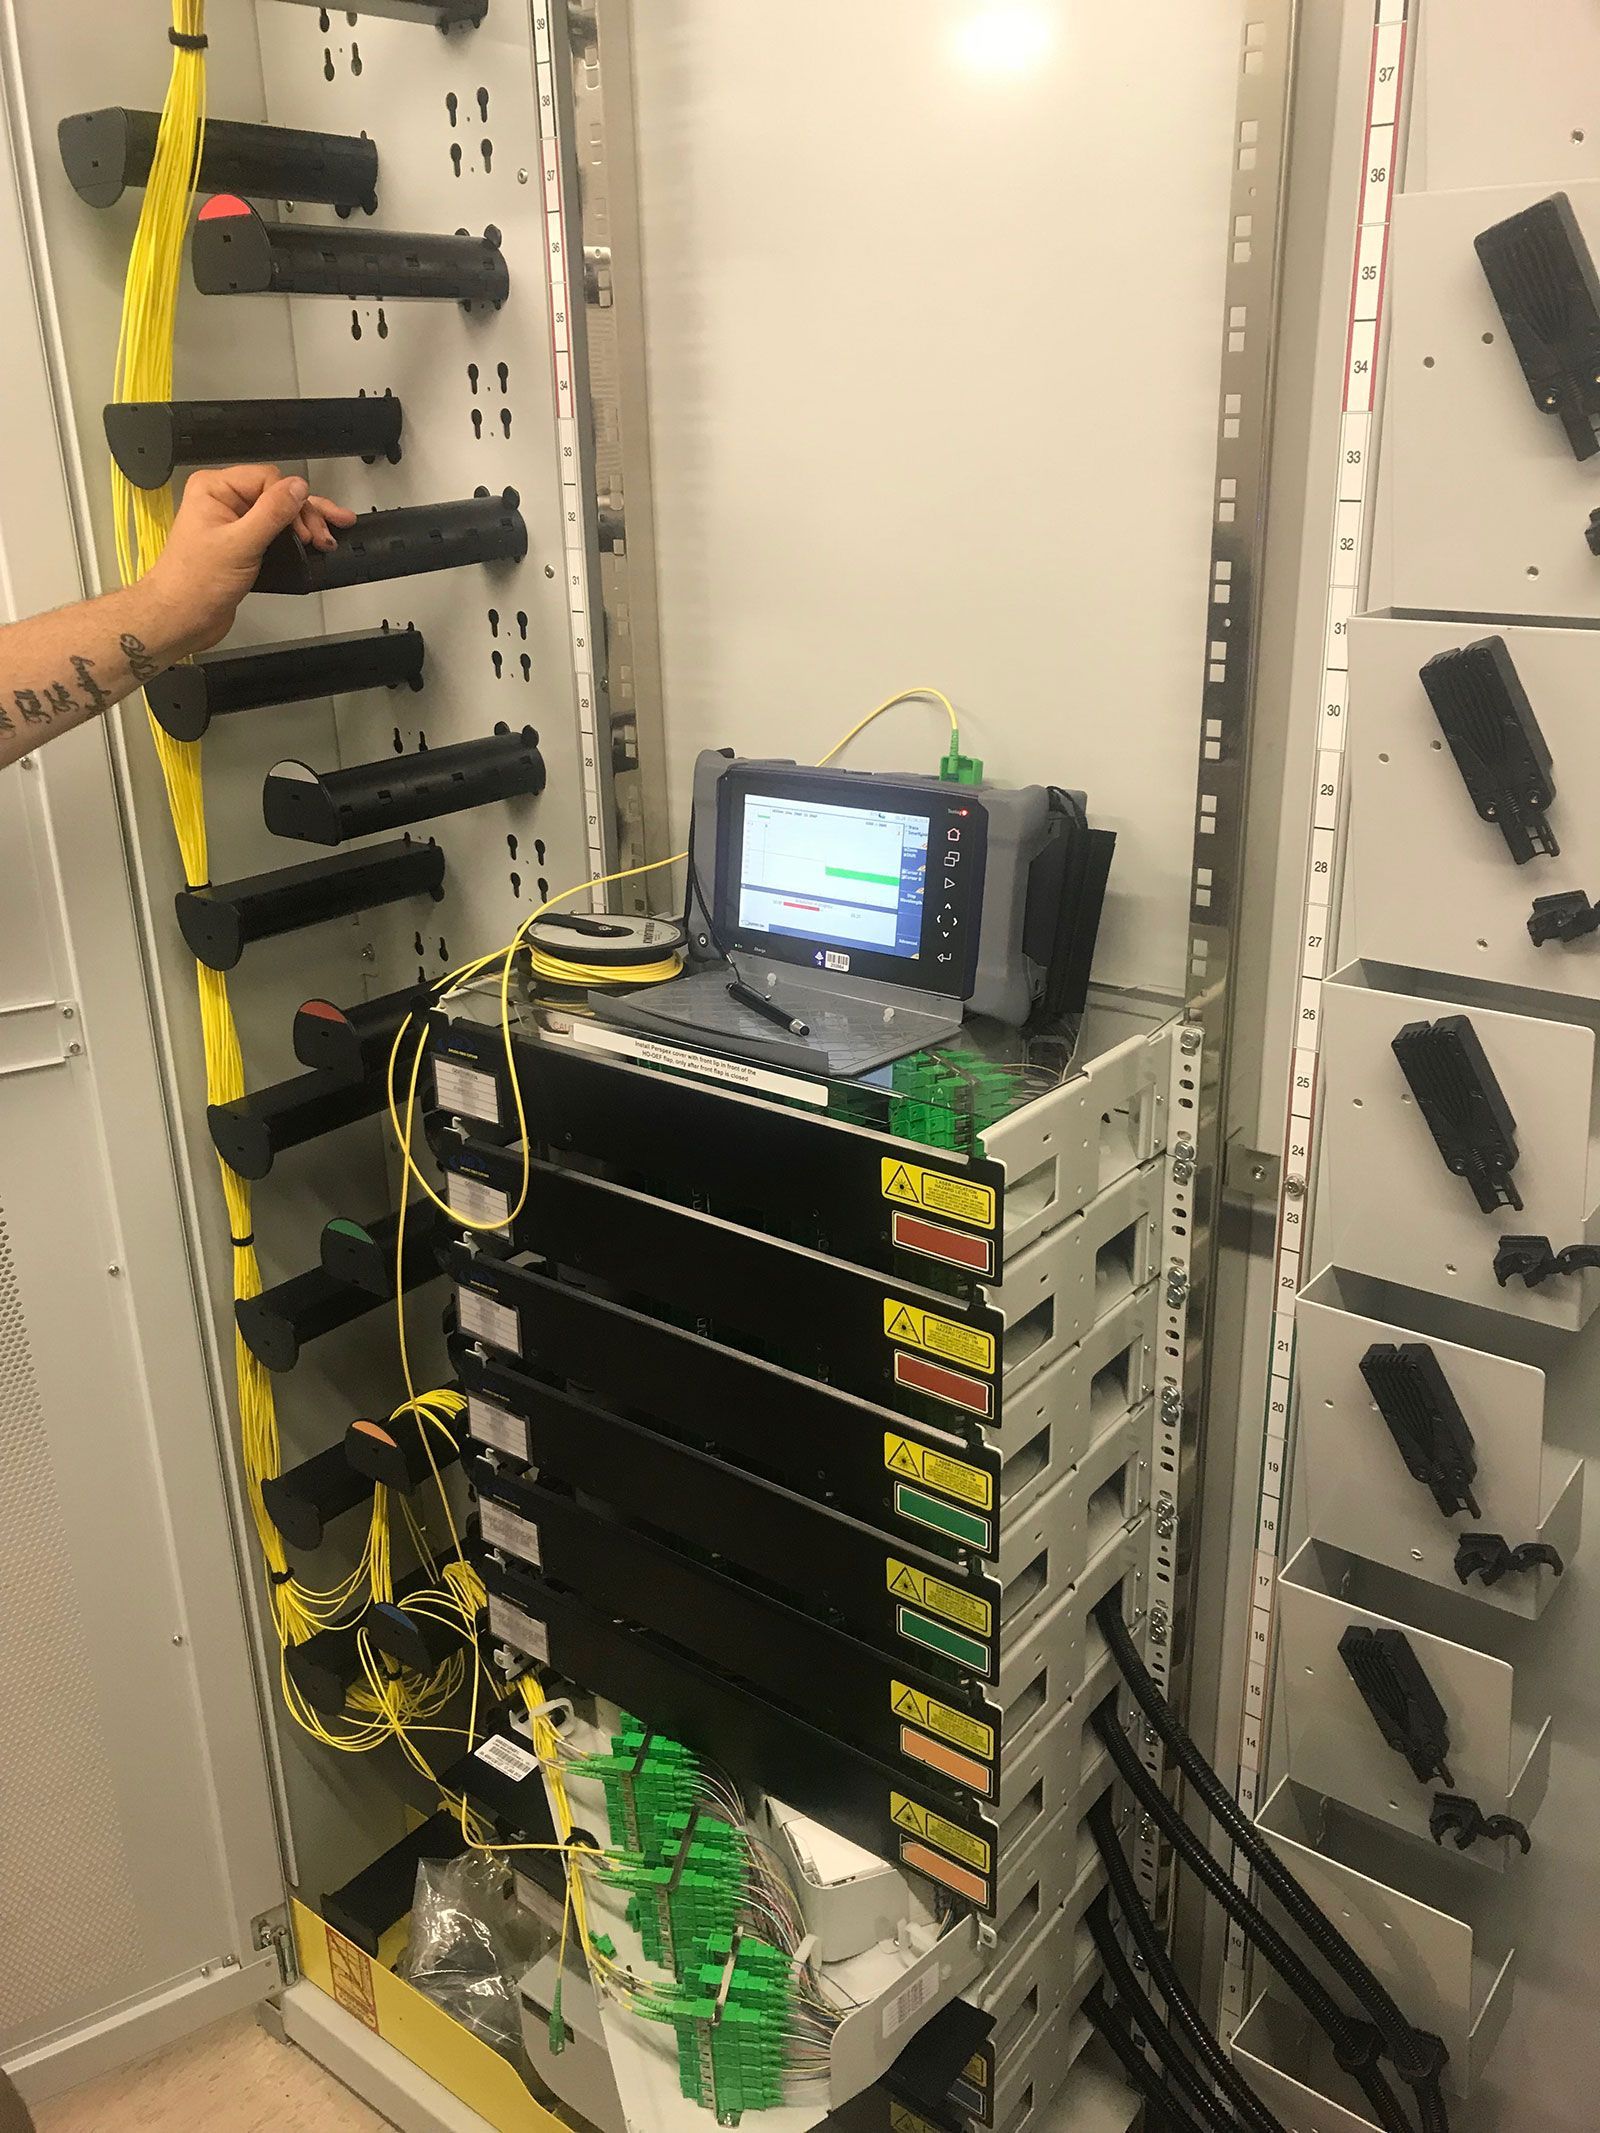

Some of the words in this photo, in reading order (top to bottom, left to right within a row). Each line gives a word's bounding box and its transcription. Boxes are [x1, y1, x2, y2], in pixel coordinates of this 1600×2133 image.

[536, 18, 545, 31] 39
[1378, 66, 1395, 83] 37
[541, 94, 551, 107] 38
[546, 169, 555, 182] 37
[1370, 167, 1386, 183] 36
[551, 241, 561, 254] 36
[1361, 265, 1377, 281] 35
[555, 312, 565, 323] 35
[1353, 360, 1369, 374] 34
[559, 380, 568, 391] 34
[563, 446, 573, 457] 33
[1346, 450, 1361, 464] 33
[567, 511, 576, 522] 32
[1340, 537, 1354, 551] 32
[572, 575, 580, 586] 31
[1334, 622, 1348, 635] 31
[576, 637, 585, 648] 30
[580, 698, 590, 709] 29
[1326, 704, 1341, 717] 30
[585, 757, 594, 768] 28
[1320, 783, 1334, 797] 29
[588, 815, 597, 825] 27
[1314, 860, 1328, 874] 28
[1308, 935, 1323, 948] 27
[1302, 1008, 1316, 1021] 26
[634, 1040, 650, 1049] Install
[672, 1050, 687, 1058] cover
[699, 1056, 712, 1064] front
[727, 1063, 740, 1071] front
[747, 1068, 757, 1076] the
[675, 1059, 686, 1067] only
[700, 1064, 713, 1072] front
[730, 1073, 749, 1082] closed
[1296, 1076, 1310, 1089] 25
[1291, 1144, 1305, 1157] 24
[1286, 1212, 1299, 1224] 23
[1281, 1276, 1295, 1289] 22
[1277, 1340, 1289, 1353] 21
[1271, 1401, 1285, 1414] 20
[1268, 1461, 1279, 1473] 19
[1263, 1519, 1275, 1531] 18
[1258, 1575, 1270, 1587] 17
[1254, 1631, 1265, 1642] 16
[1250, 1684, 1261, 1696] 15
[1246, 1737, 1256, 1748] 14
[1242, 1788, 1253, 1800] 13
